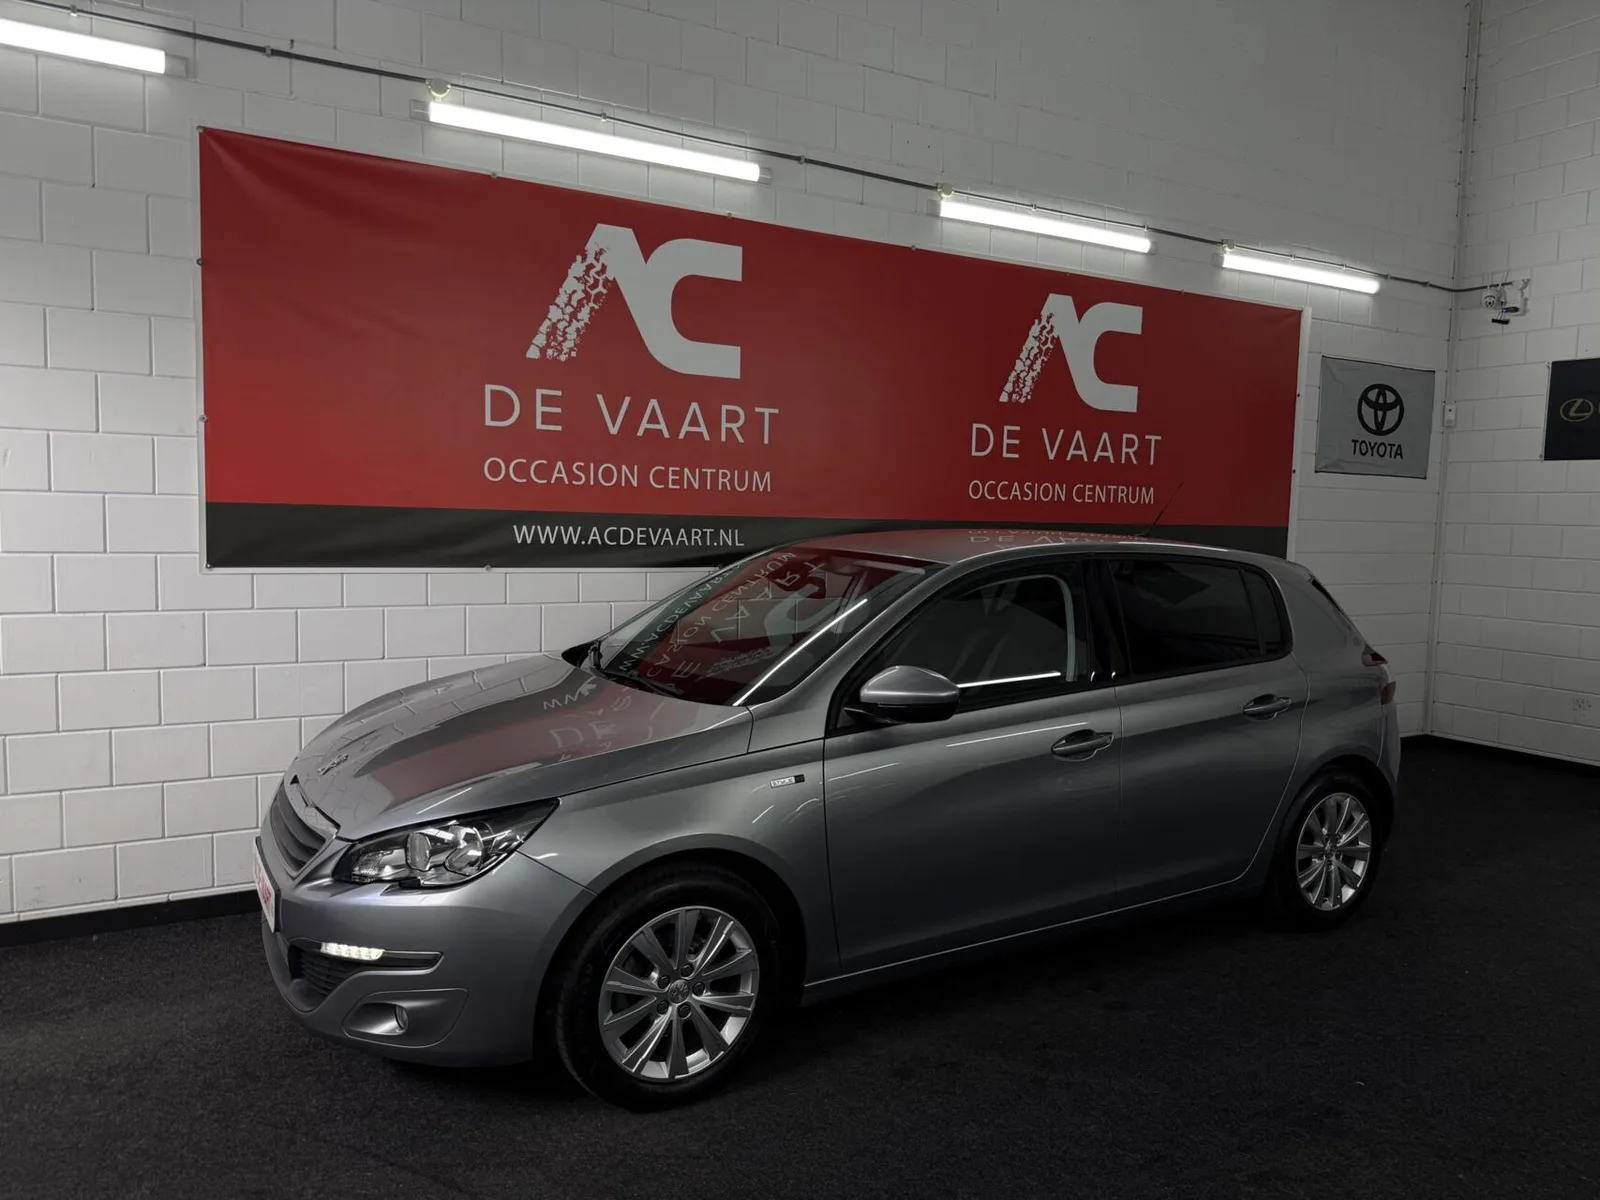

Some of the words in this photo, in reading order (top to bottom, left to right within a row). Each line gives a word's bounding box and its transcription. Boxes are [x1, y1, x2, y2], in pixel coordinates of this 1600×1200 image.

[484, 384, 562, 431] DE
[596, 393, 779, 445] VAART
[970, 423, 1021, 459] DE
[1042, 427, 1162, 466] VAART
[1351, 439, 1404, 460] TOYOTA
[483, 457, 639, 488] OCCASION
[649, 466, 772, 492] CENTRUM
[968, 480, 1066, 502] OCCASION
[1072, 484, 1155, 505] CENTRUM
[513, 524, 745, 546] WWW.ACDEVAART.NL
